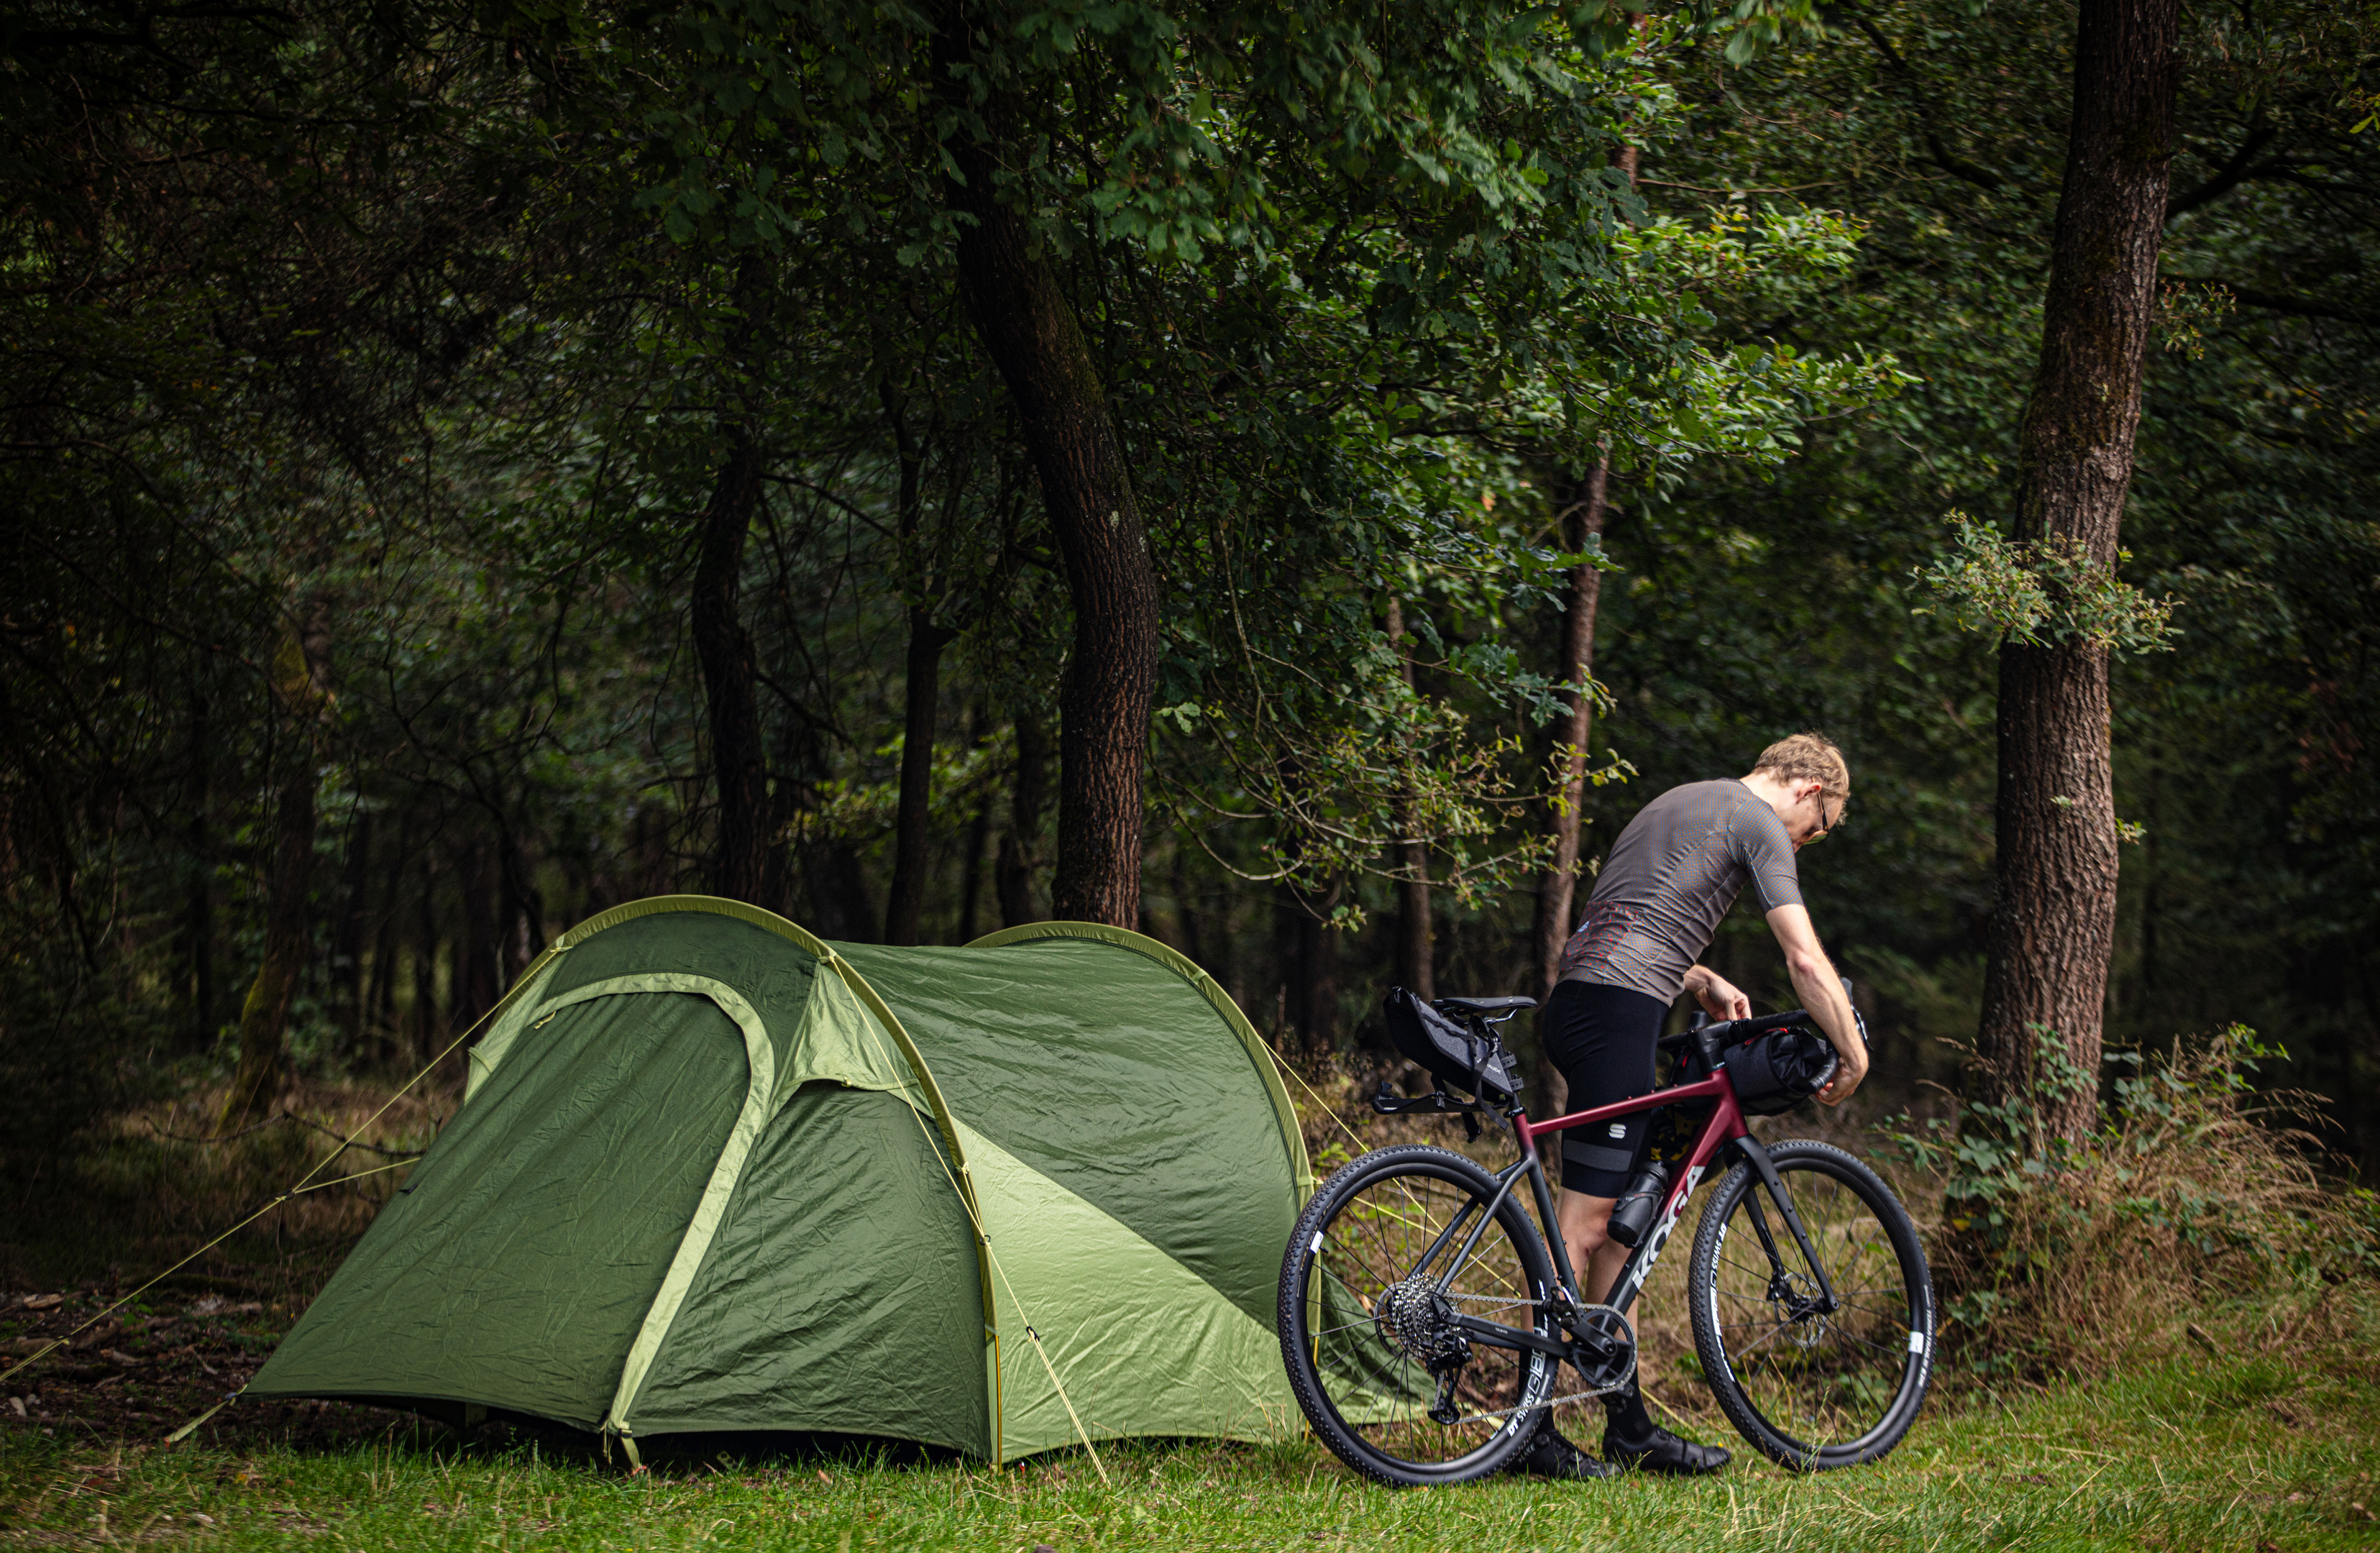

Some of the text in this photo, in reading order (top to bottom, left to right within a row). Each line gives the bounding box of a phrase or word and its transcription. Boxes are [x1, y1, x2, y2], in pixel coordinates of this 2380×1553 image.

[1631, 1165, 1706, 1291] KOGA
[1718, 1222, 1727, 1242] DT
[1711, 1239, 1722, 1270] SWISS
[1507, 1418, 1519, 1437] DT
